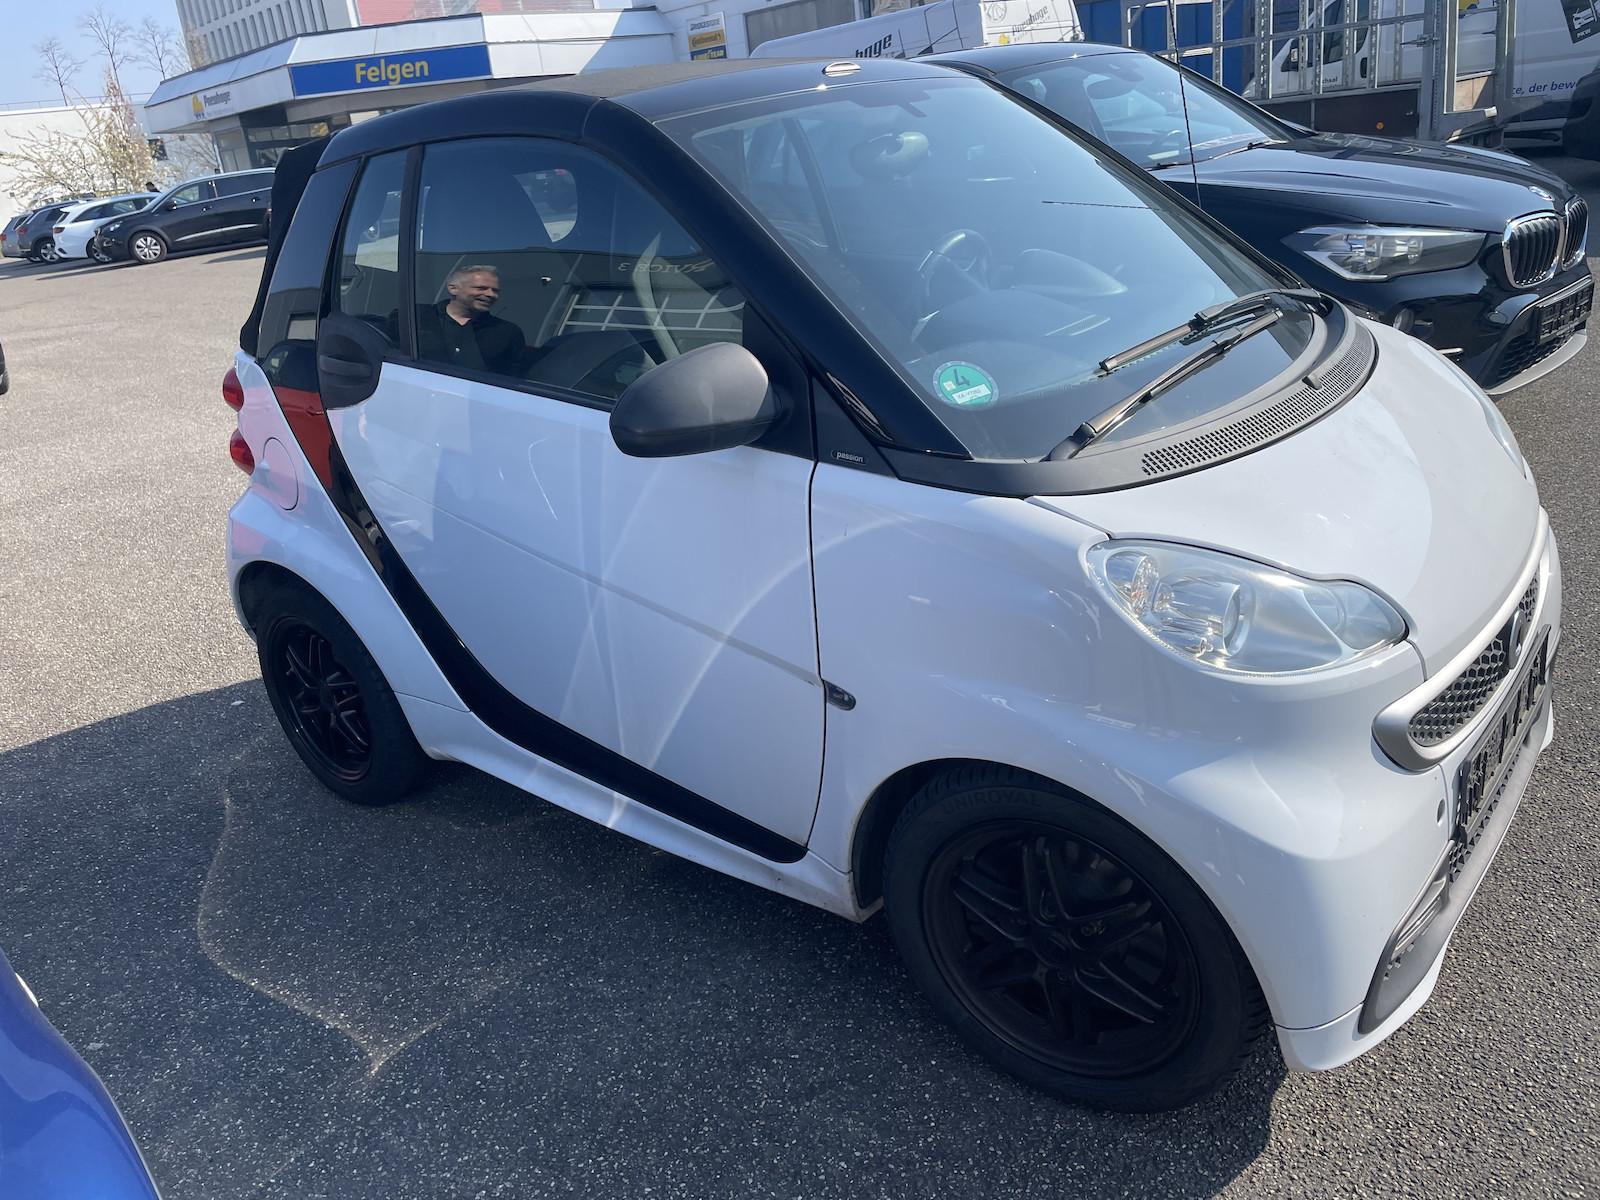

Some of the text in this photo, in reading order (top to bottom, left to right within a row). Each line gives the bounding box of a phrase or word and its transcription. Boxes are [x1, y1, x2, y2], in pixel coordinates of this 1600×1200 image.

[355, 58, 429, 86] Felgen
[1528, 82, 1547, 93] der
[1550, 80, 1576, 91] bew
[953, 368, 970, 386] 4
[836, 451, 864, 463] passion
[943, 790, 1041, 815] UNIROYAL
